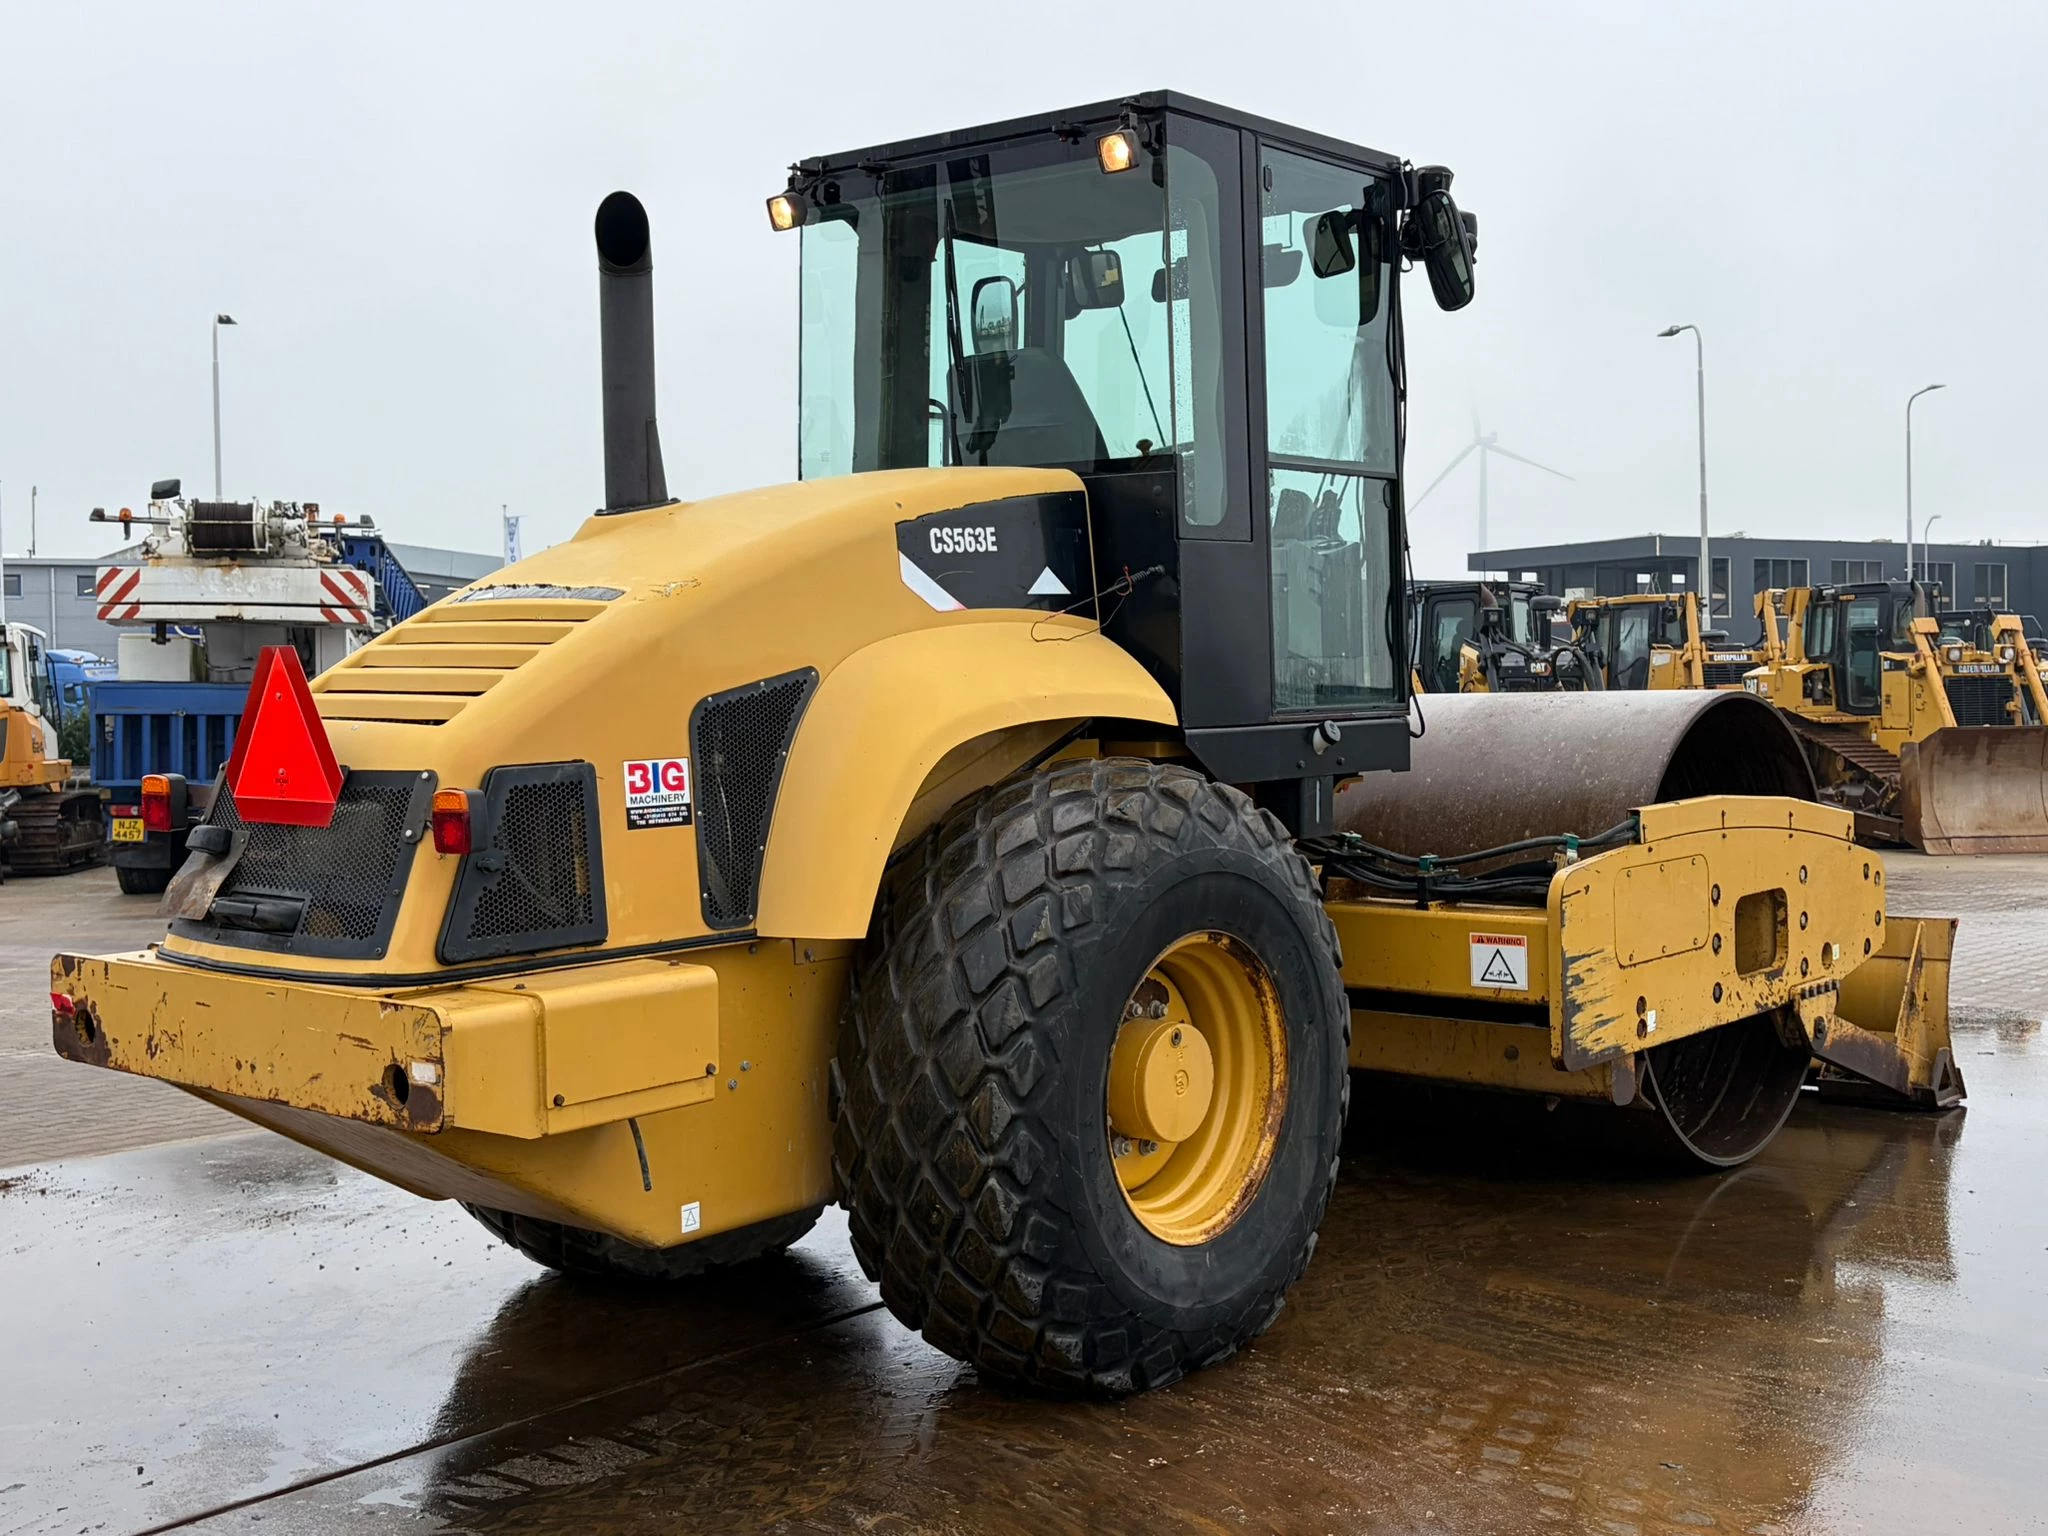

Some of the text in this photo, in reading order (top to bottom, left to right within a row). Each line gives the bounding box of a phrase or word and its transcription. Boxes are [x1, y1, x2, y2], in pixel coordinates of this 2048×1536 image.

[929, 526, 998, 554] CS563E
[1530, 662, 1547, 673] CAT
[628, 761, 685, 794] BIG
[630, 793, 686, 804] MACHINERY
[1486, 936, 1521, 945] WARNING
